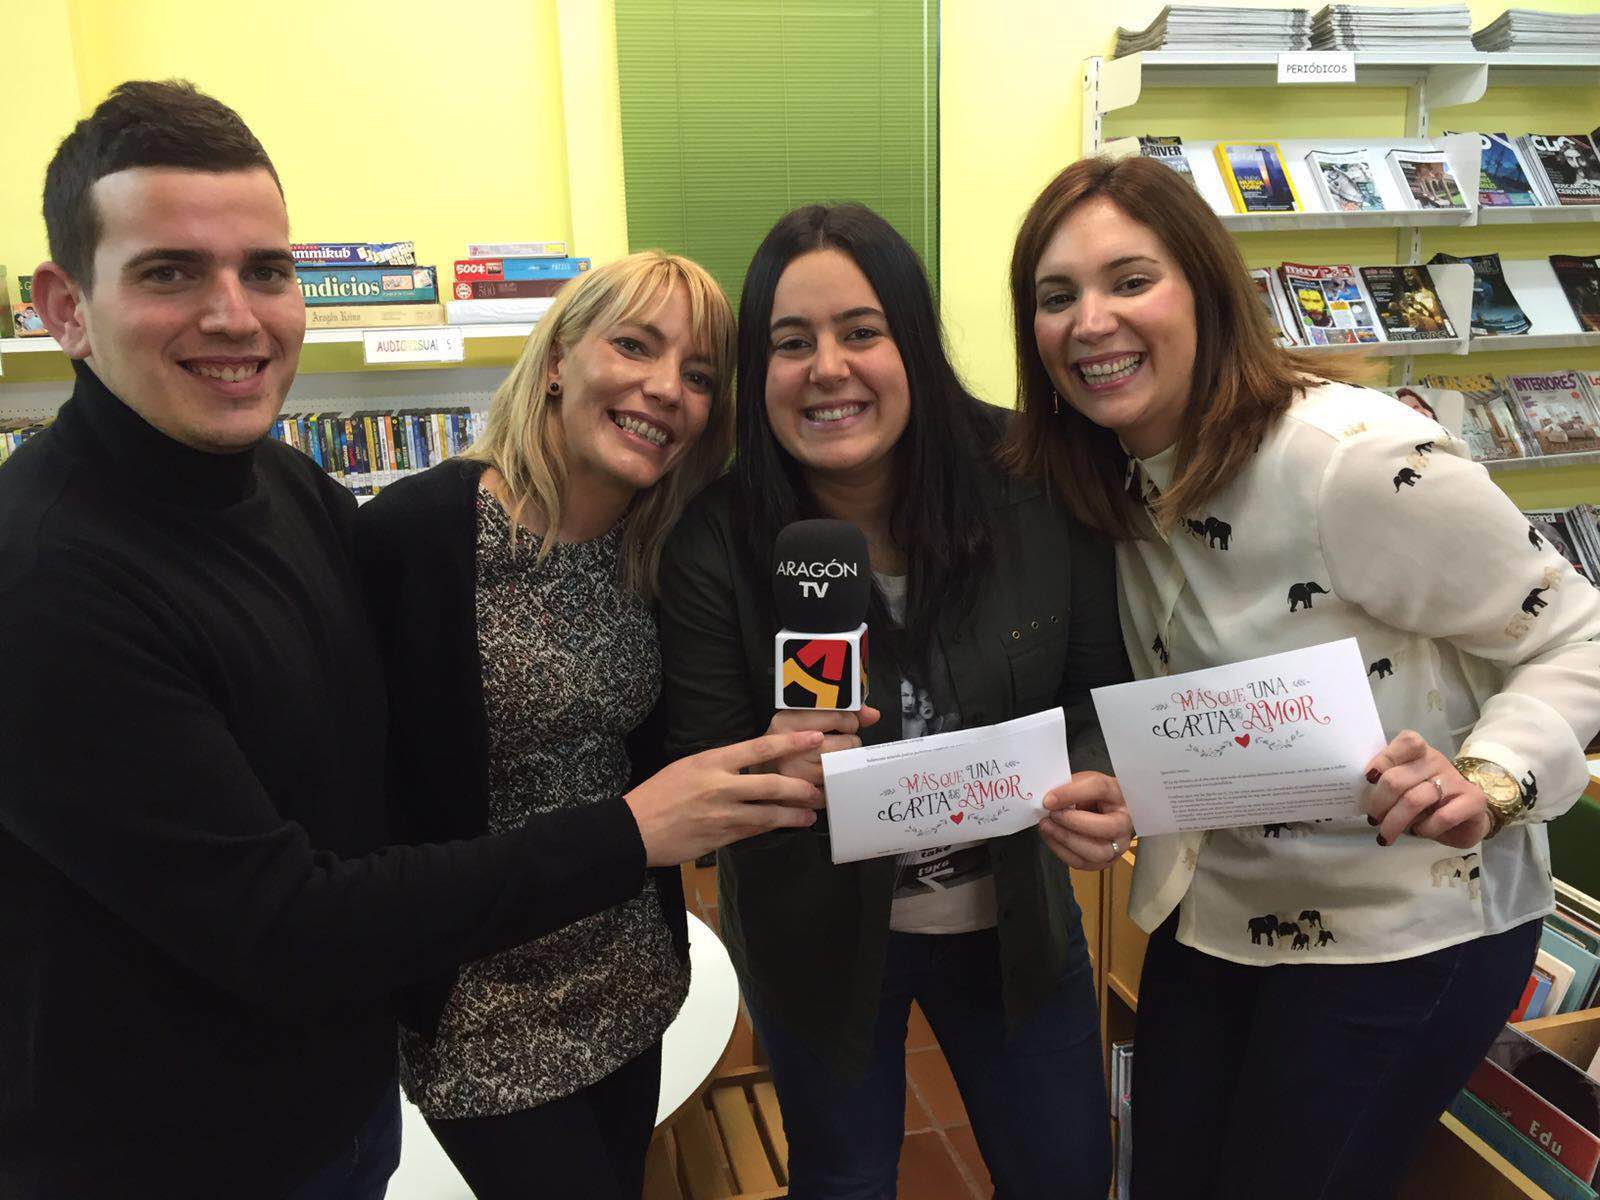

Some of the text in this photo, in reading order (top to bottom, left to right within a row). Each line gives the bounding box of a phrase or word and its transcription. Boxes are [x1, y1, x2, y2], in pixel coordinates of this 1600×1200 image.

[1286, 61, 1348, 74] PERIÓDICOS
[291, 247, 350, 259] ummikub
[297, 276, 380, 297] indicios
[376, 338, 452, 353] AUDIOVISUALS
[1512, 373, 1577, 392] INTERIORES
[776, 559, 858, 578] ARAGÓN
[799, 581, 829, 598] TV
[1171, 676, 1289, 712] MÁS QUE UNA
[1152, 711, 1236, 740] CARTA
[1242, 695, 1331, 733] AMOR
[899, 759, 1001, 795] MÁS QUE UNA
[878, 791, 951, 822] CARTA
[958, 774, 1034, 810] AMOR
[1528, 1120, 1563, 1157] Edu
